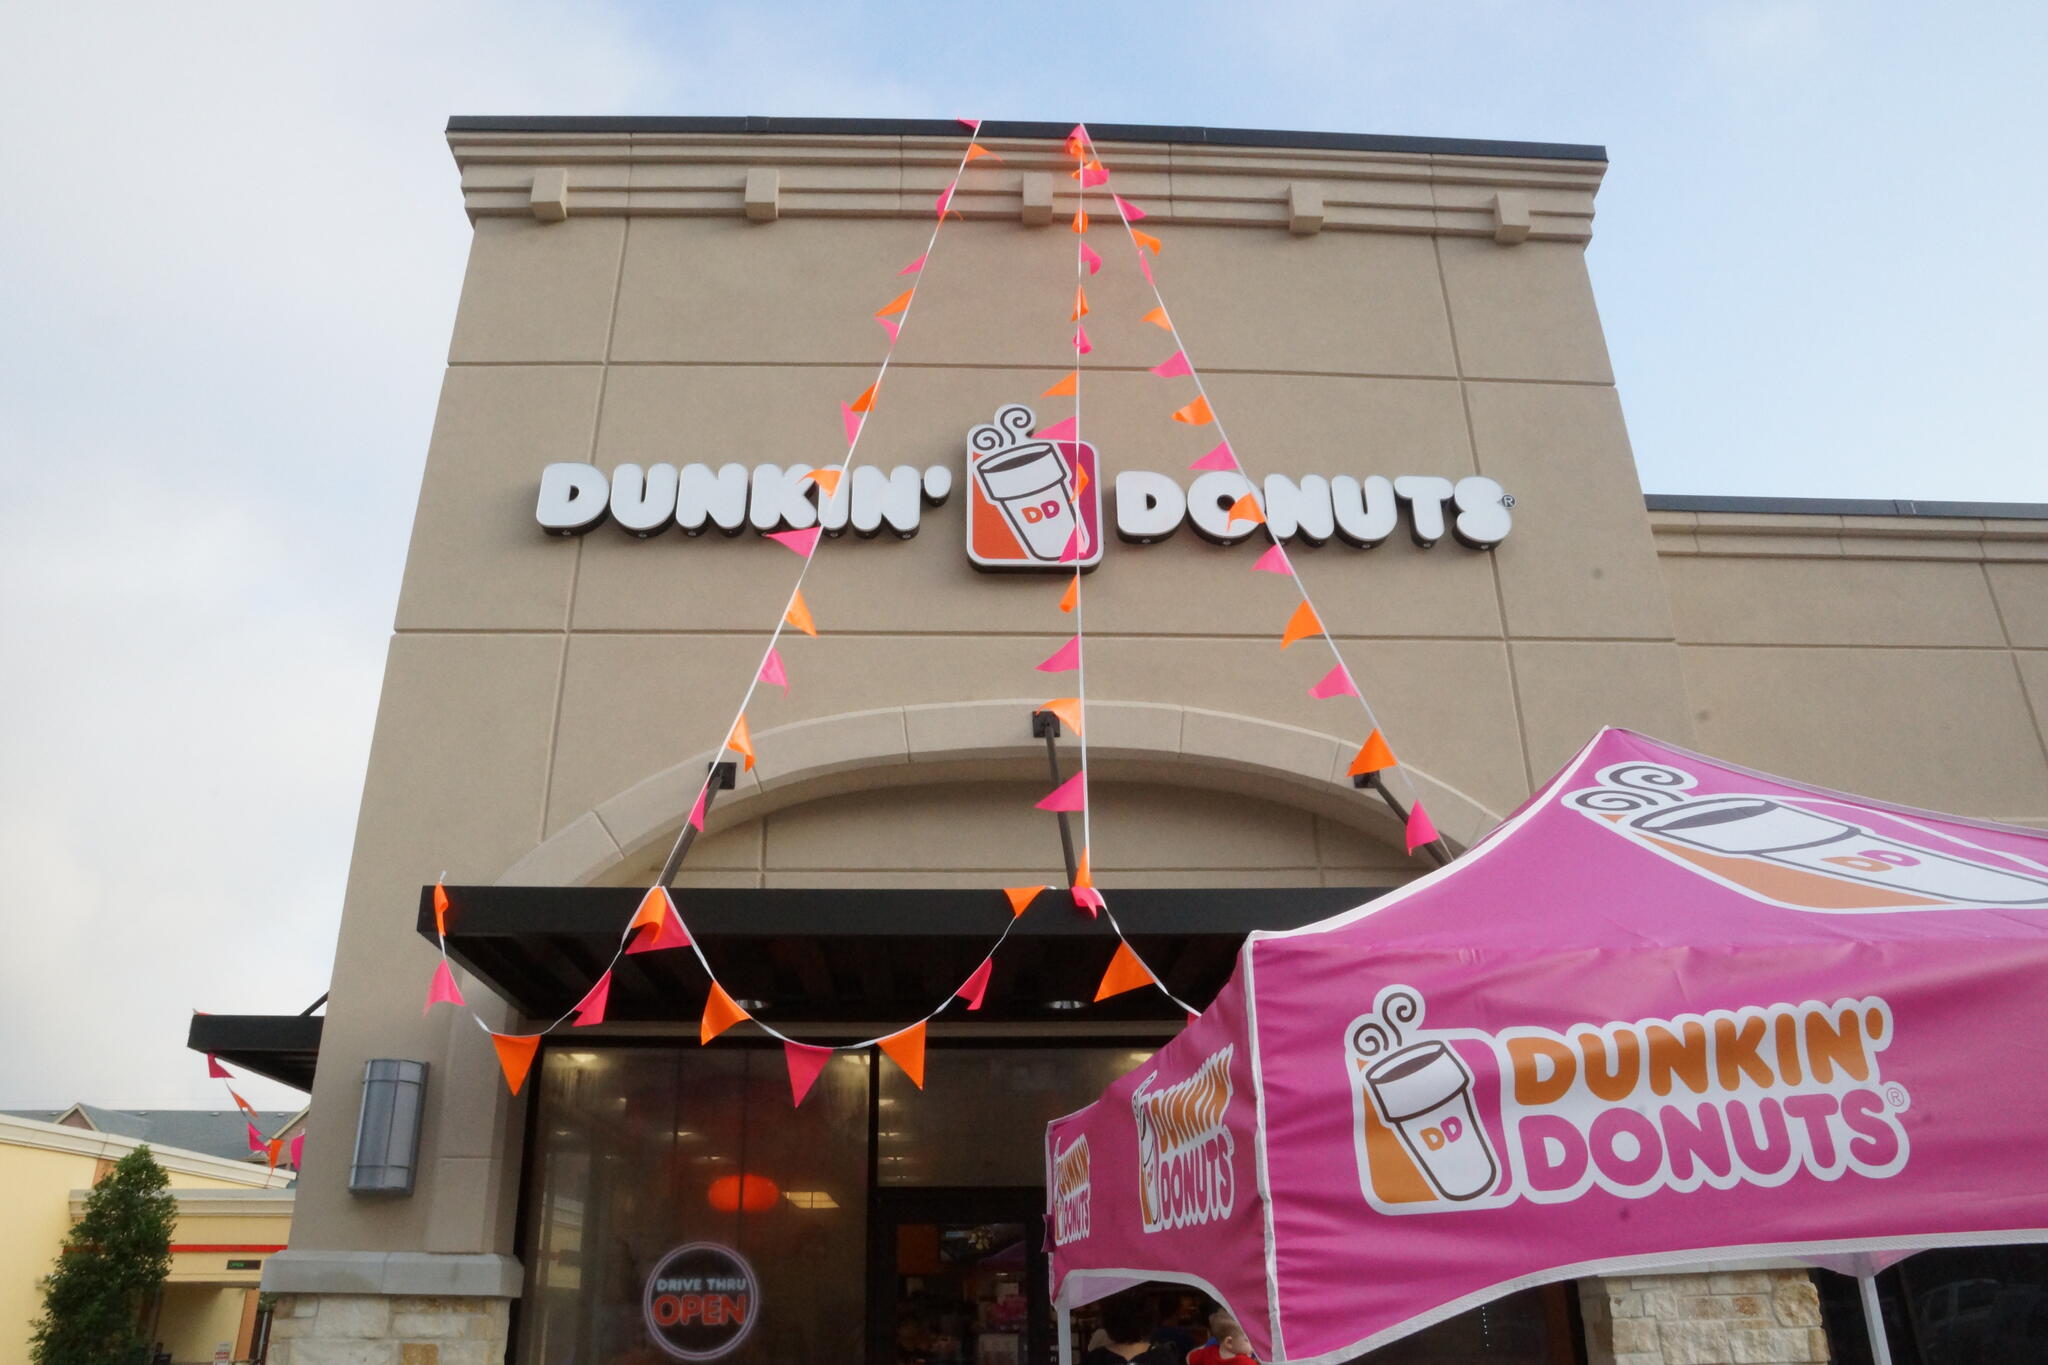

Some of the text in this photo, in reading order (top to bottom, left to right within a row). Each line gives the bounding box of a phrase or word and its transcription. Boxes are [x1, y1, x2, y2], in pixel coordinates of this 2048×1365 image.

[536, 462, 1512, 545] DUNKIN' DONUTS
[1021, 500, 1060, 524] DD
[1507, 1007, 1884, 1105] DUNKIN'
[1420, 1116, 1463, 1151] DD
[1518, 1089, 1900, 1192] DONUTS
[1160, 1132, 1229, 1220] DONUTS
[653, 1294, 747, 1326] OPEN
[656, 1278, 746, 1291] DRIVE THRU
